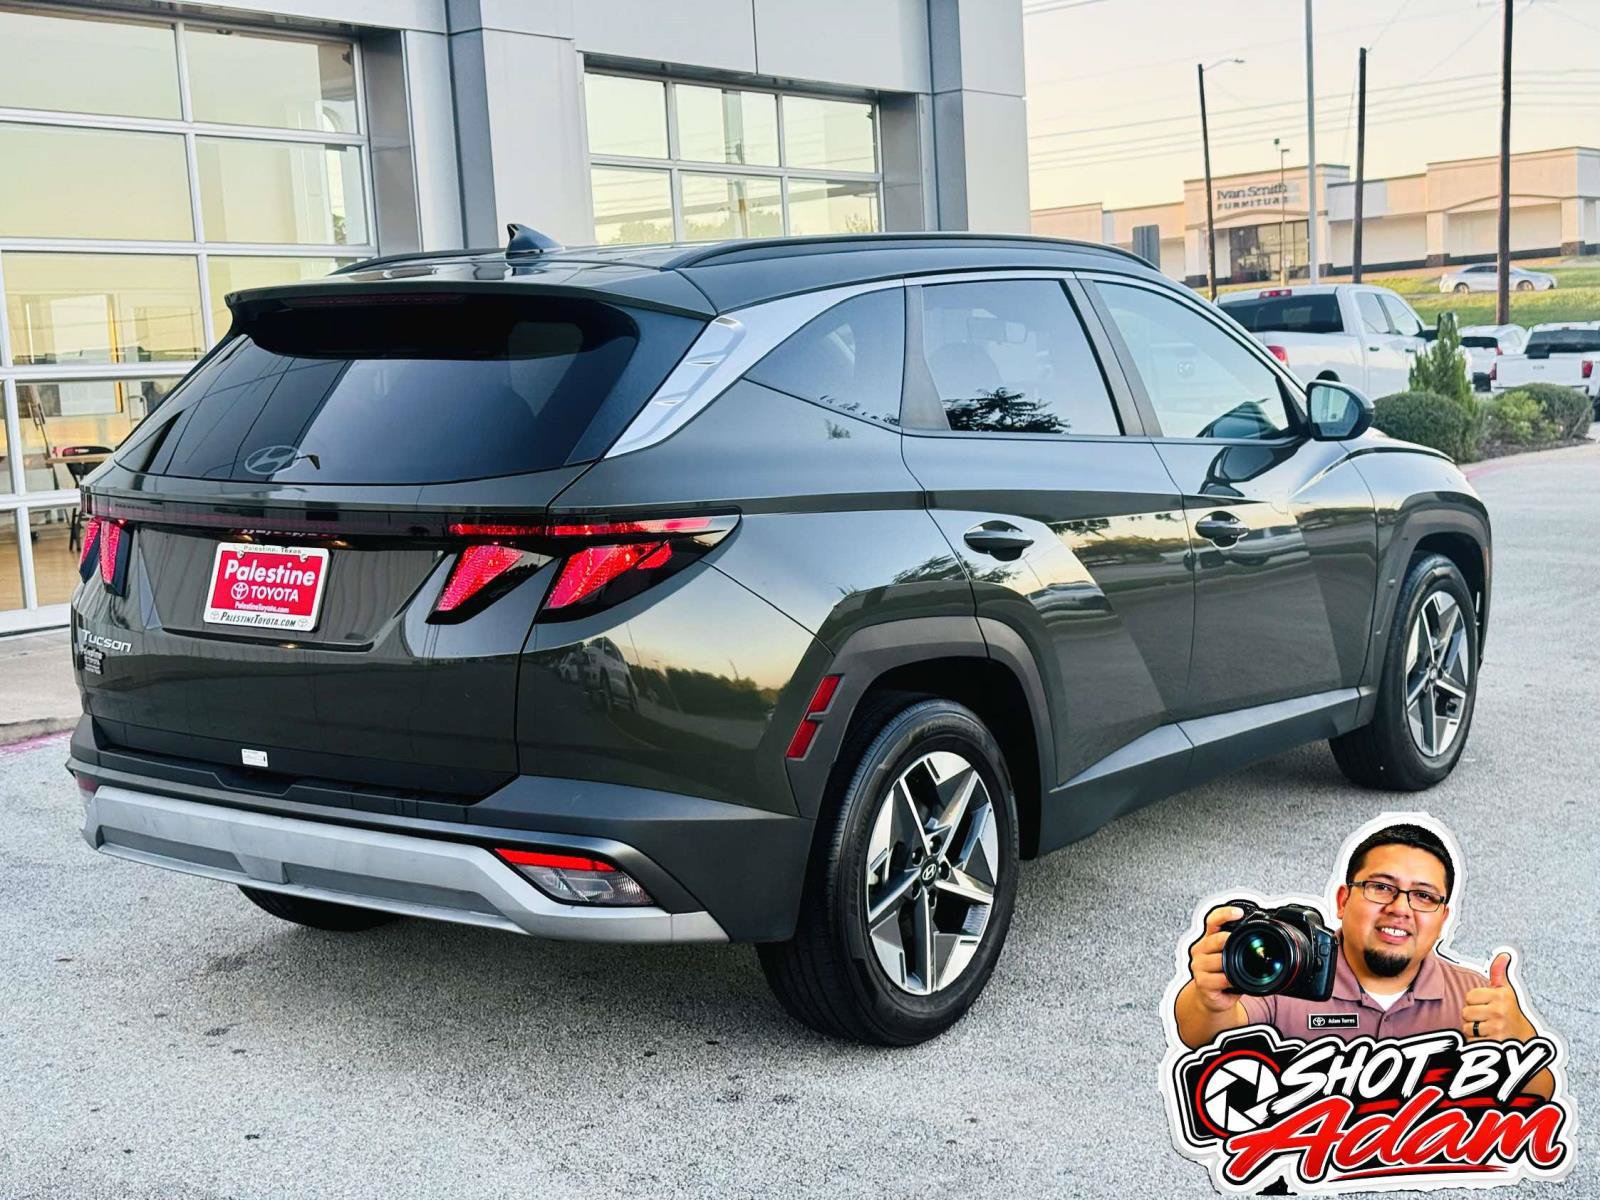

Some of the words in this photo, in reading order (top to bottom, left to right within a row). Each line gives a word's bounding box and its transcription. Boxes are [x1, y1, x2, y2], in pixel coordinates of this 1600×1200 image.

[1217, 189, 1246, 200] Ivan
[1247, 183, 1288, 197] Smith
[1217, 196, 1288, 211] FURNITURE
[224, 559, 316, 587] Palestine
[250, 585, 299, 603] TOYOTA
[81, 629, 132, 653] Tucson
